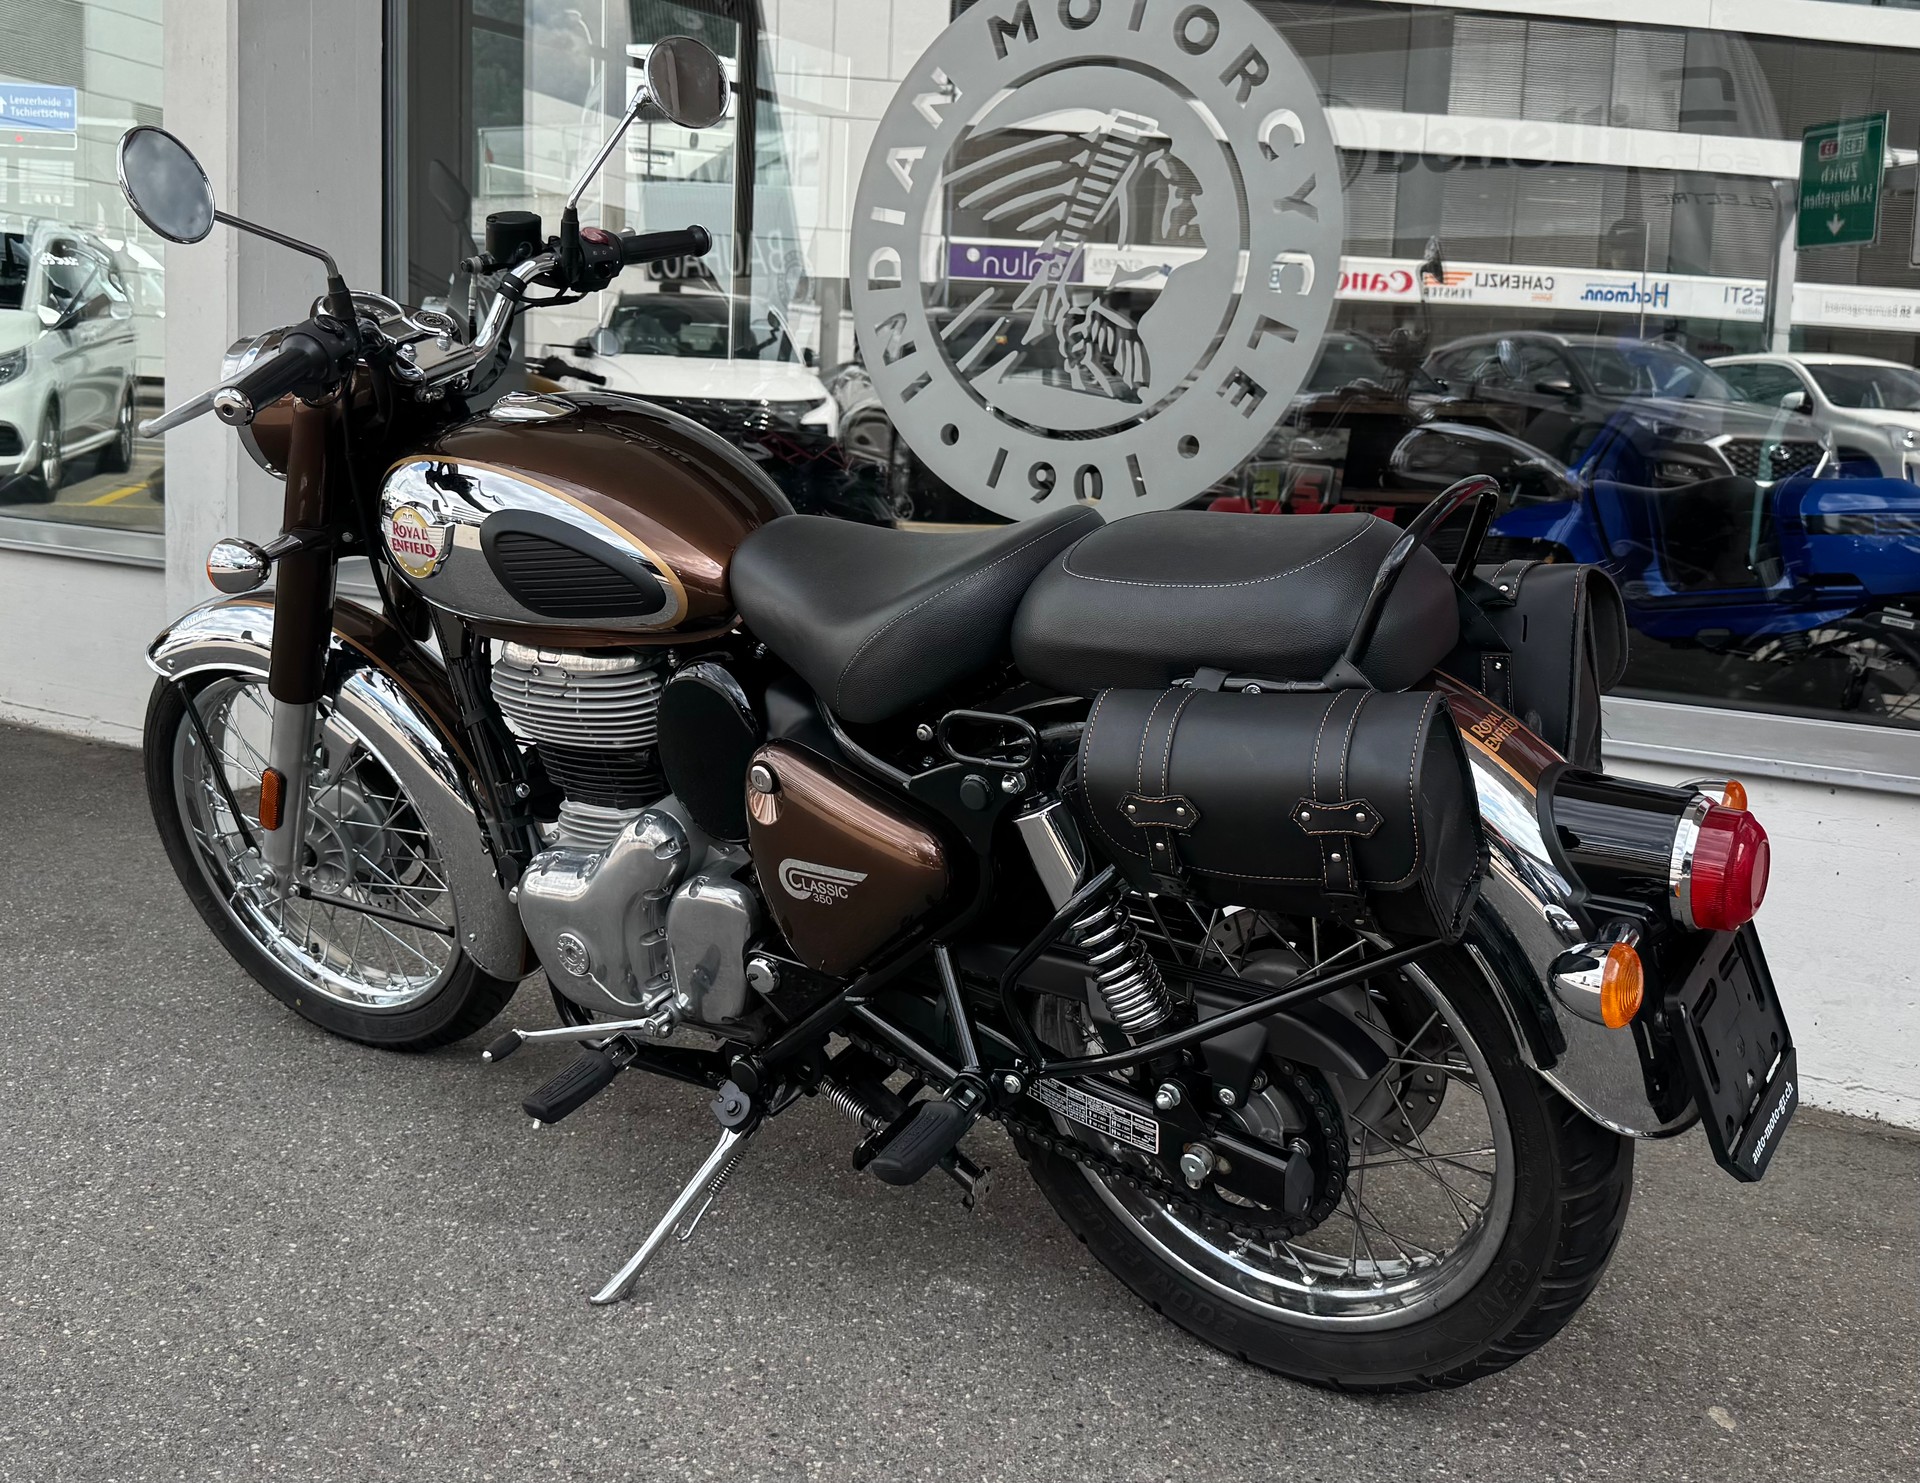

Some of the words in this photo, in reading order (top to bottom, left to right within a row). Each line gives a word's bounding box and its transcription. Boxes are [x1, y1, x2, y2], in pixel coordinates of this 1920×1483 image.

[9, 94, 62, 107] Lenzerheide
[10, 105, 70, 119] Tschiertschen
[868, 66, 963, 404] INDIAN
[986, 447, 1147, 507] 1901
[392, 520, 428, 541] ROYAL
[391, 537, 437, 558] ENFIELD
[1470, 711, 1503, 738] ROYAL
[1483, 718, 1519, 752] ENFIELD
[786, 866, 858, 900] CLASSIC
[812, 893, 833, 905] 350
[1752, 1081, 1794, 1165] auto-moto-gr.ch
